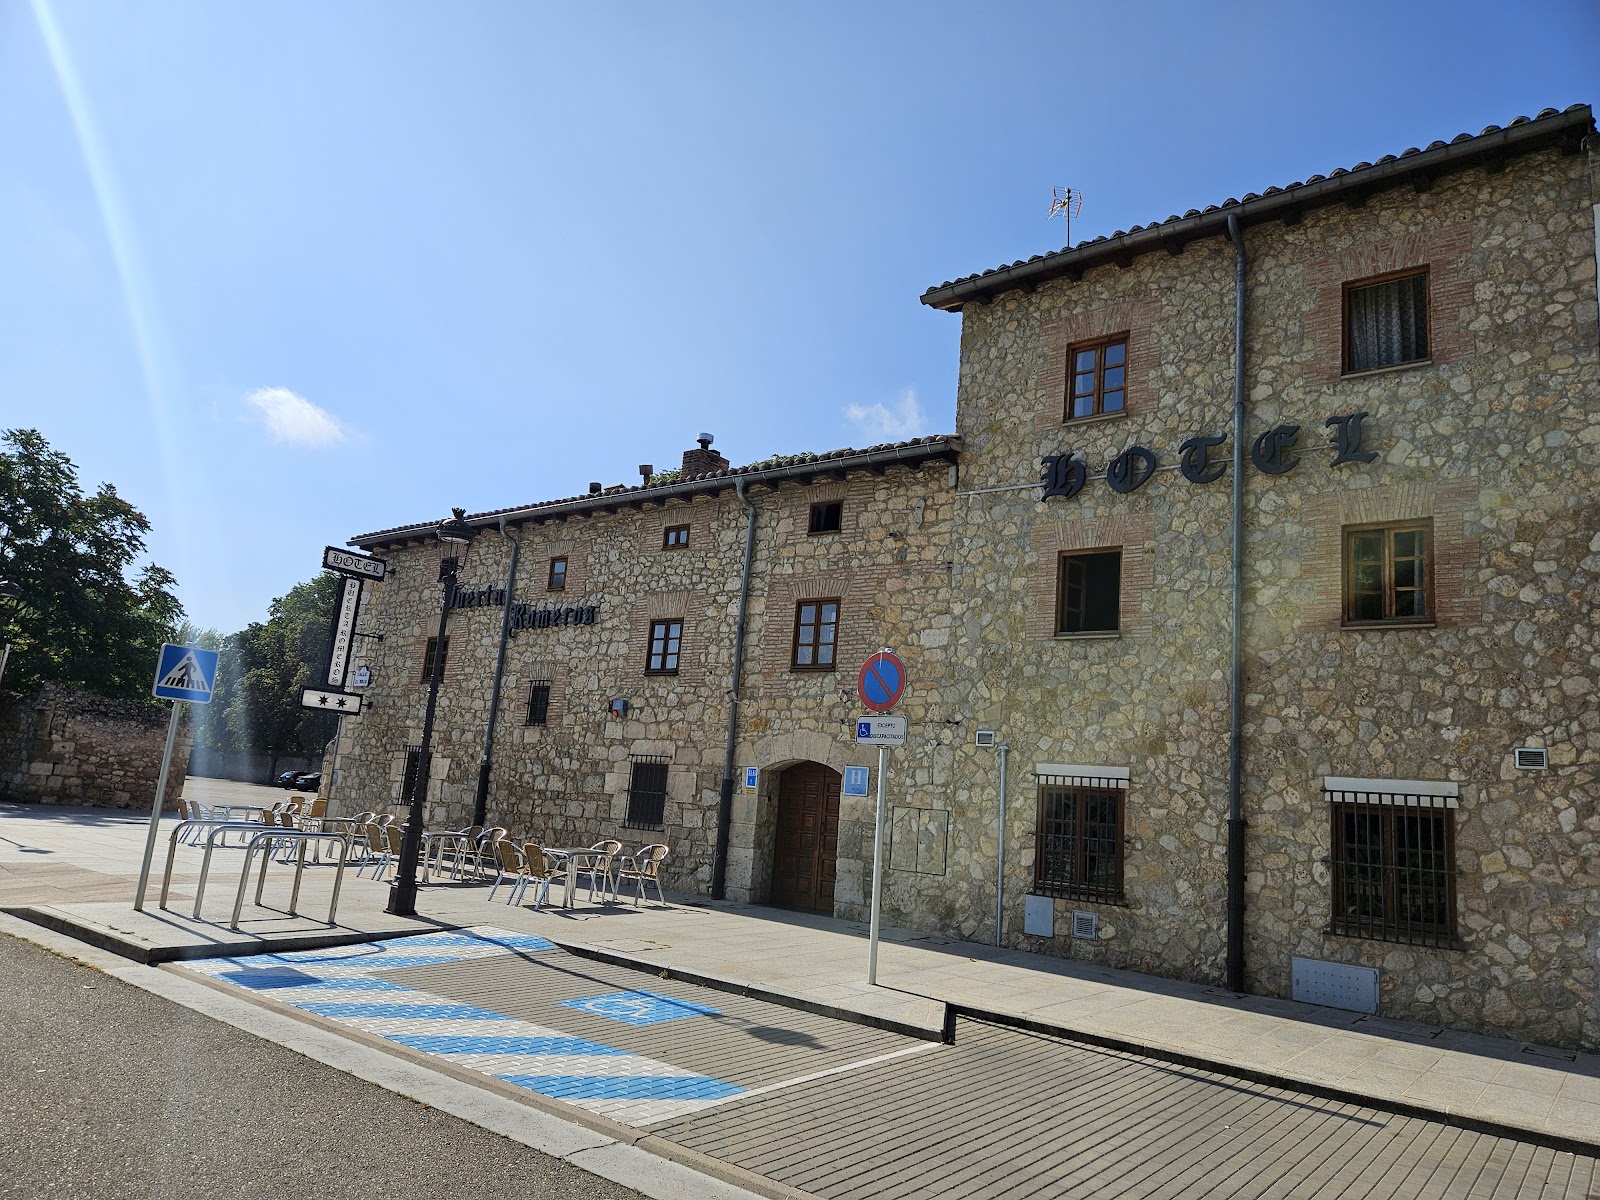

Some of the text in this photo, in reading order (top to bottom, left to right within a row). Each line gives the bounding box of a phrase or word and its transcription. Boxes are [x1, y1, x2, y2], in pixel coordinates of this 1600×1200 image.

[1040, 411, 1381, 503] HOTEL
[332, 551, 382, 575] HOTEL
[509, 603, 600, 638] Romeros
[331, 629, 348, 685] ROMEROS
[850, 769, 863, 785] H
